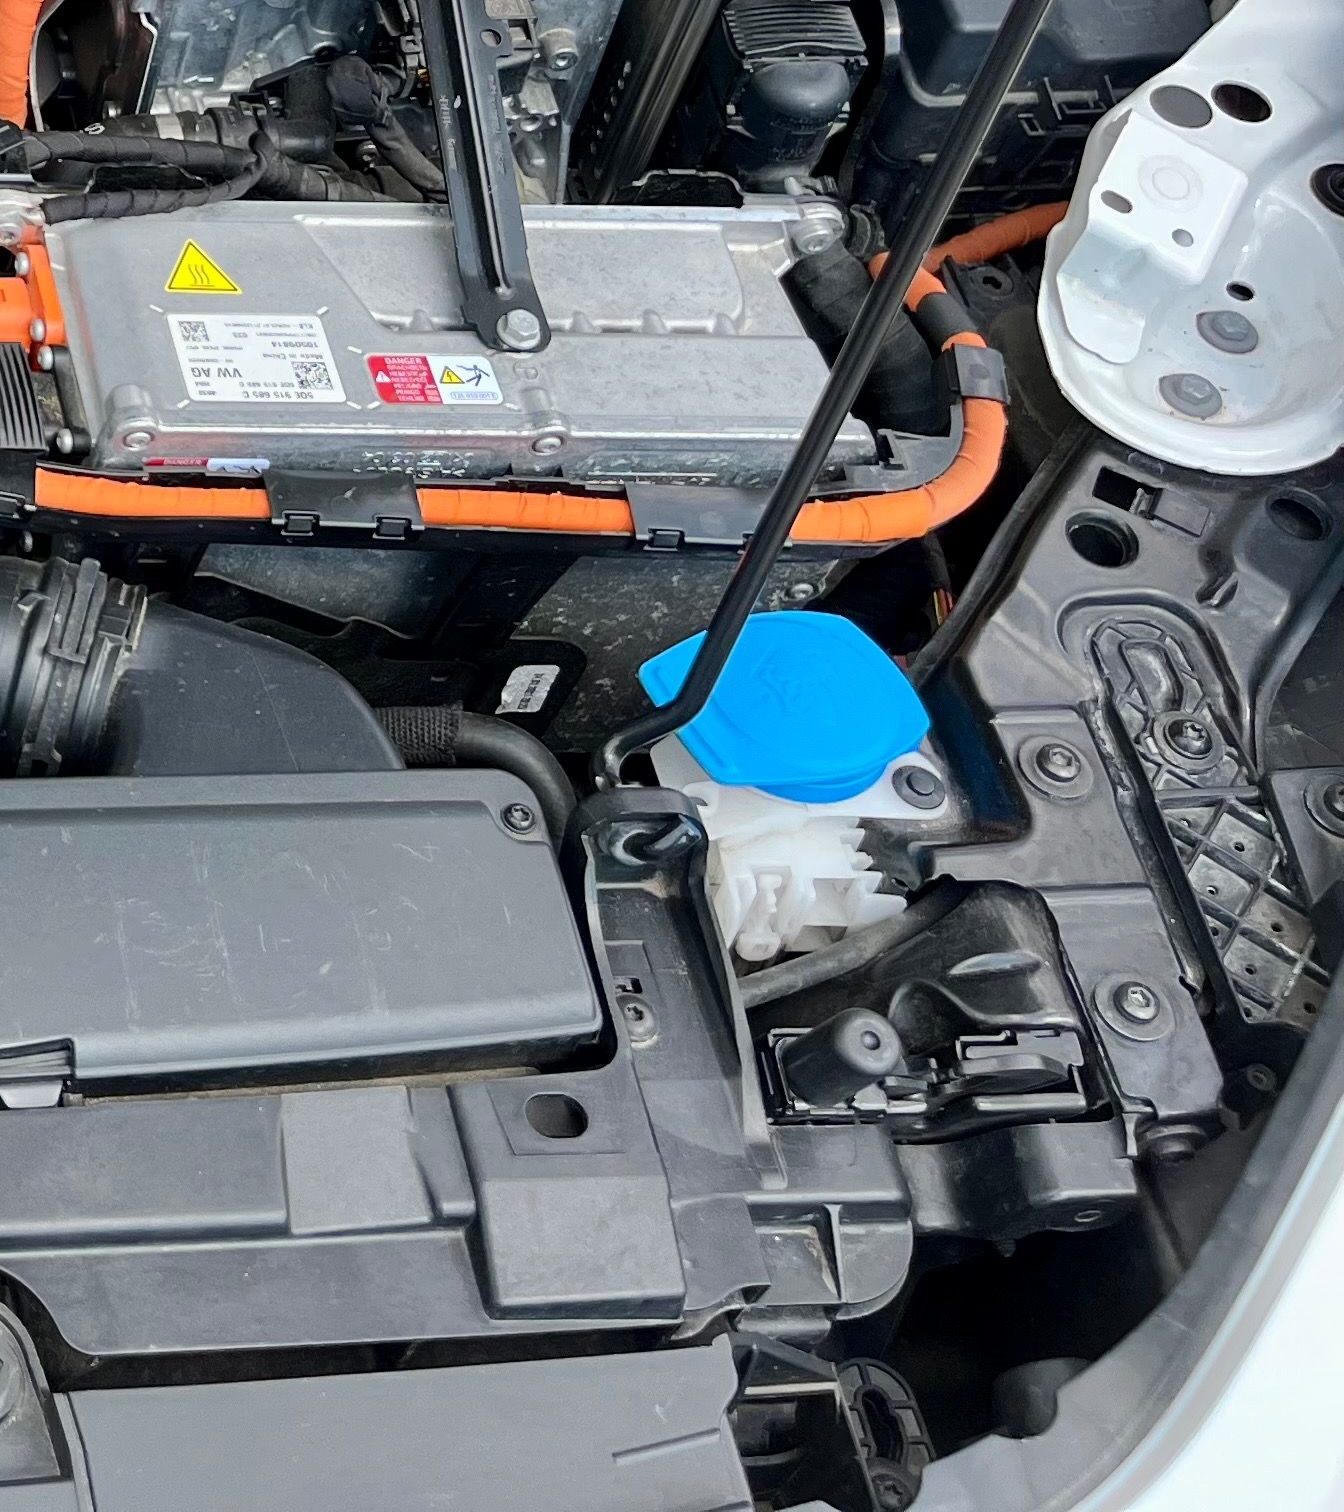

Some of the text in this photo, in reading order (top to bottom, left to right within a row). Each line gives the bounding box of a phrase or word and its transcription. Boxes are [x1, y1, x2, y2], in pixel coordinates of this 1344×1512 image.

[384, 357, 422, 365] DANGER
[190, 367, 243, 378] VW AG
